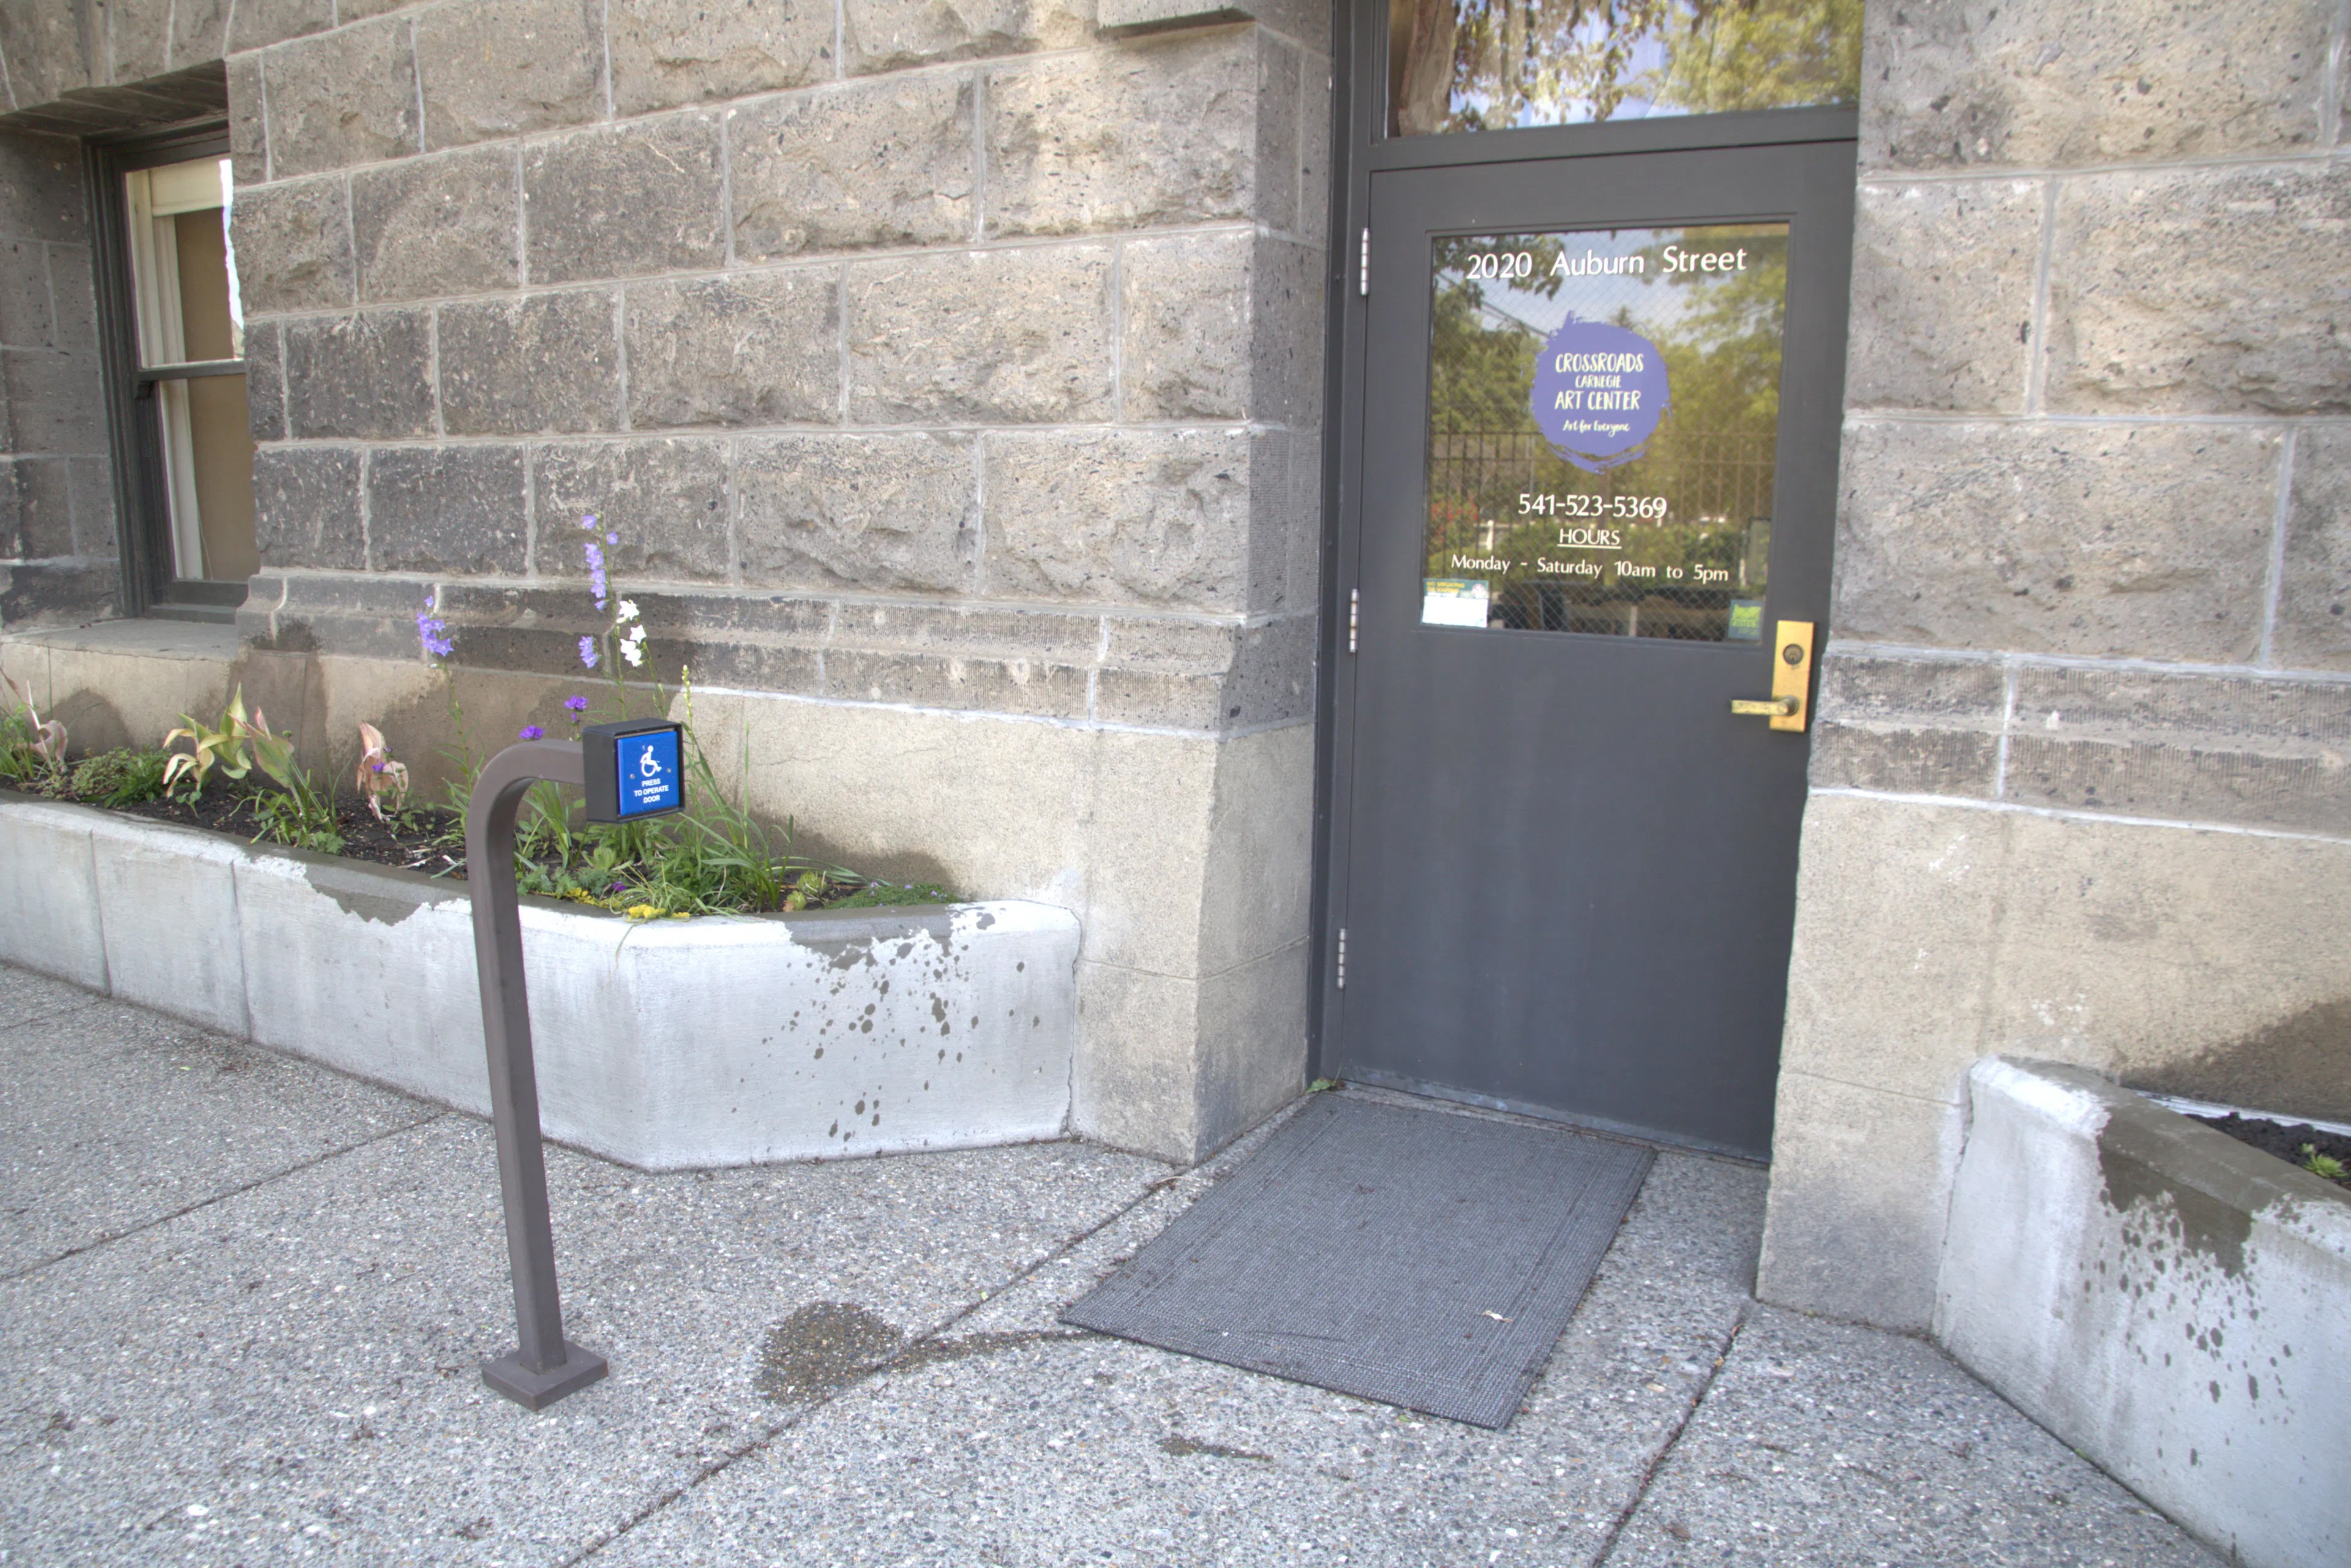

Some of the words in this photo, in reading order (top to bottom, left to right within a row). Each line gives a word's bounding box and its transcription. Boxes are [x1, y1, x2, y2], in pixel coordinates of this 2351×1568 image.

[1466, 252, 1532, 279] 2020
[1550, 249, 1644, 276] Auburn
[1663, 245, 1747, 273] Street
[1555, 352, 1644, 373] CROSSROADS
[1575, 374, 1622, 388] CARNEGIE
[1554, 389, 1584, 410] ART
[1587, 389, 1641, 410] CENTER
[1562, 419, 1578, 431] Art
[1580, 419, 1592, 433] for
[1594, 420, 1631, 437] Everyone
[1518, 493, 1667, 519] 541-523-5369
[1559, 528, 1621, 546] HOURS
[1451, 553, 1510, 575] Monday
[1537, 557, 1603, 579] Saturday
[1614, 560, 1655, 577] 10am
[1667, 566, 1683, 579] to
[1693, 563, 1728, 585] 5pm
[642, 778, 661, 787] PRESS
[643, 784, 669, 795] OPERATE
[643, 795, 661, 803] DOOR
